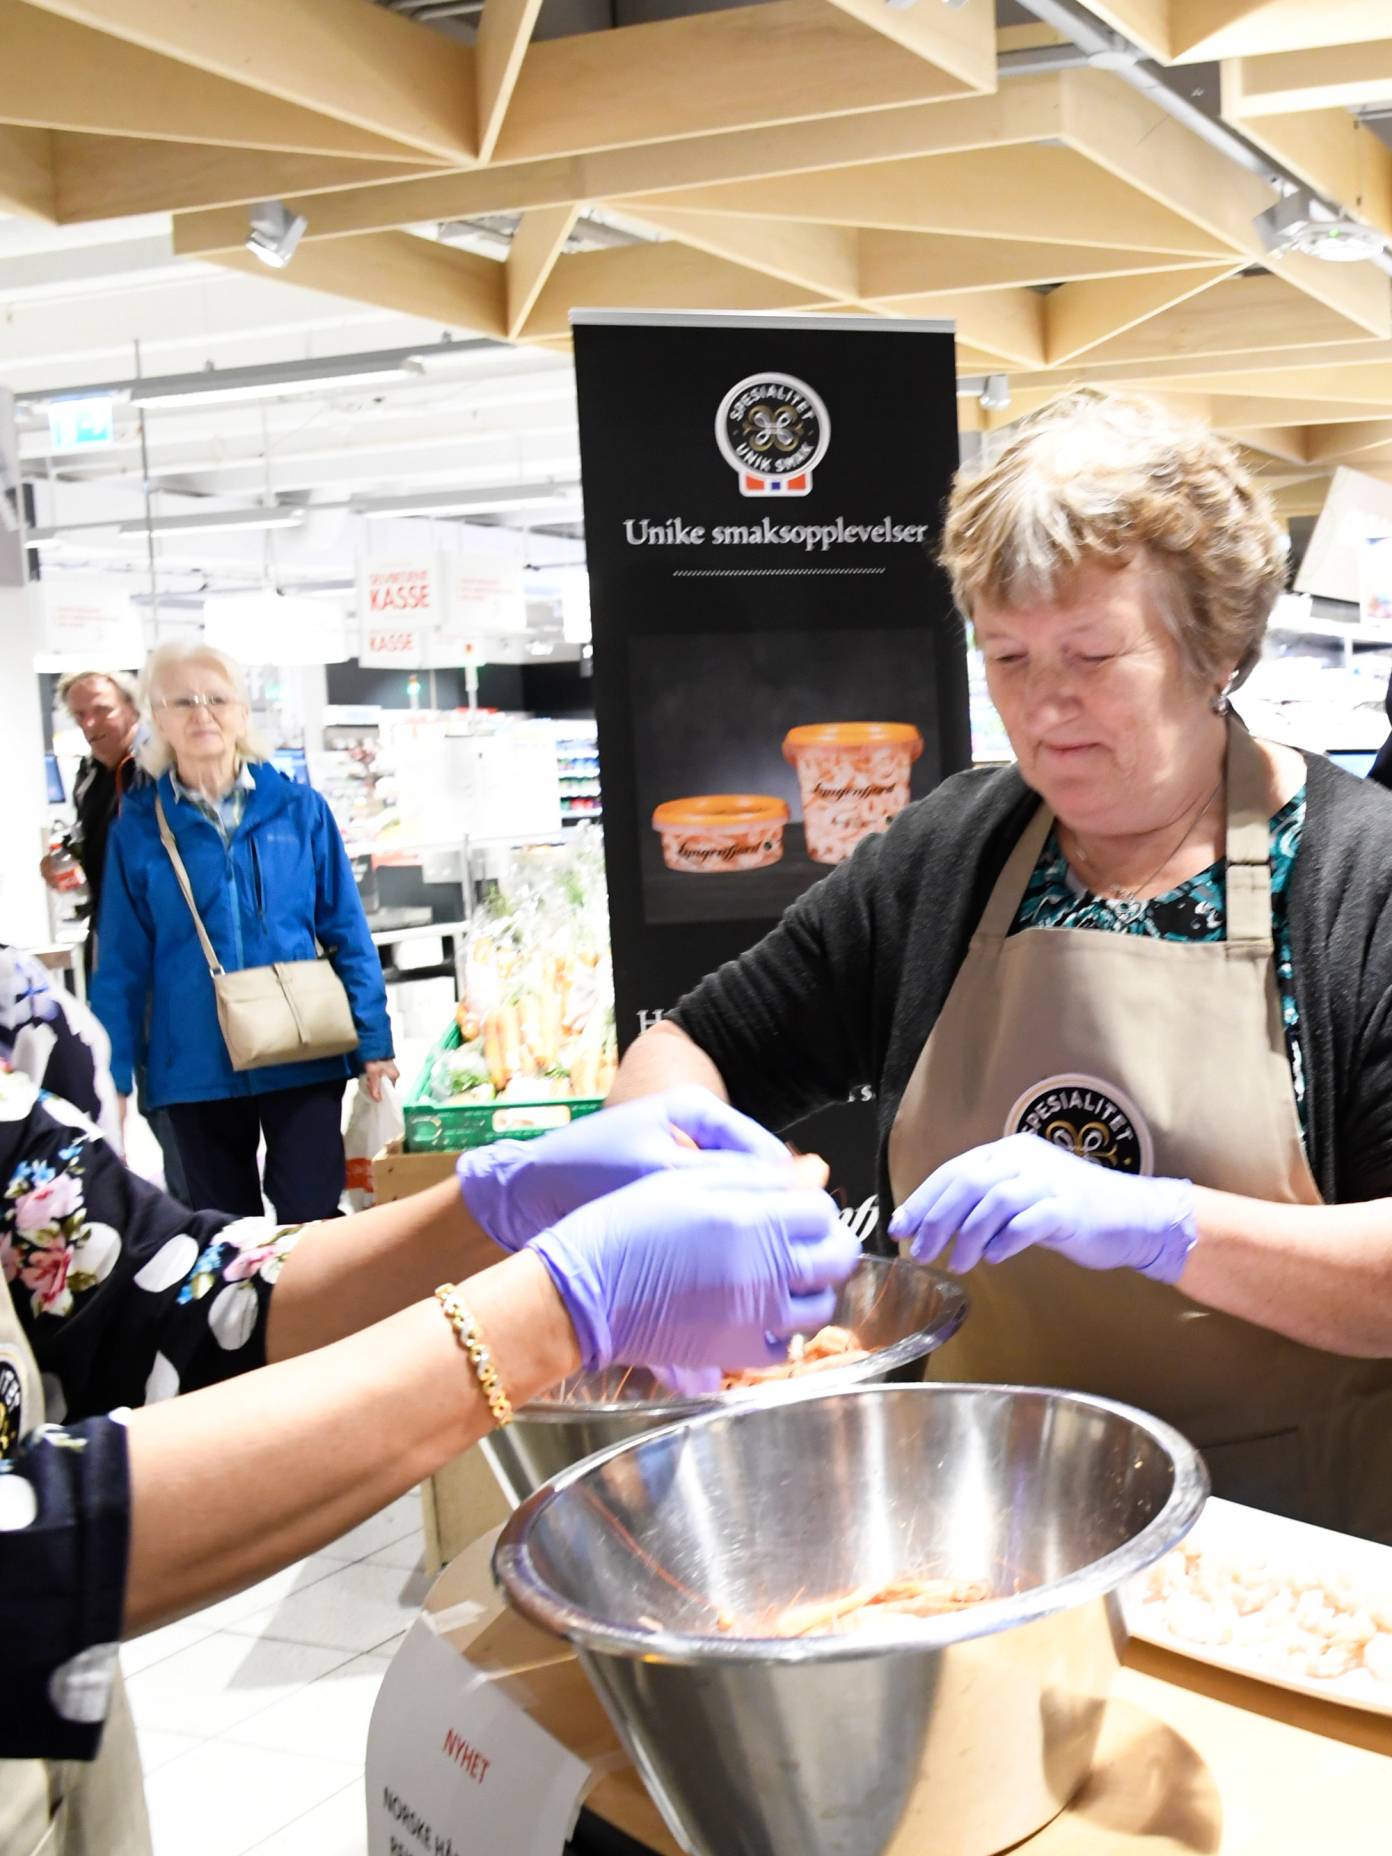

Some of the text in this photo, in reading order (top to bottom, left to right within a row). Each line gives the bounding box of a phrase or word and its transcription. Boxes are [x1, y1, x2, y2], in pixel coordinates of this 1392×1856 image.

[729, 384, 815, 421] SPESIALITET
[736, 441, 815, 472] UNIK SMAK
[622, 516, 929, 552] Unike smaksopplevelser
[369, 584, 431, 612] KASSE
[369, 632, 413, 652] KASSE
[443, 1727, 490, 1785] NYHET
[383, 1786, 432, 1852] NORSKE
